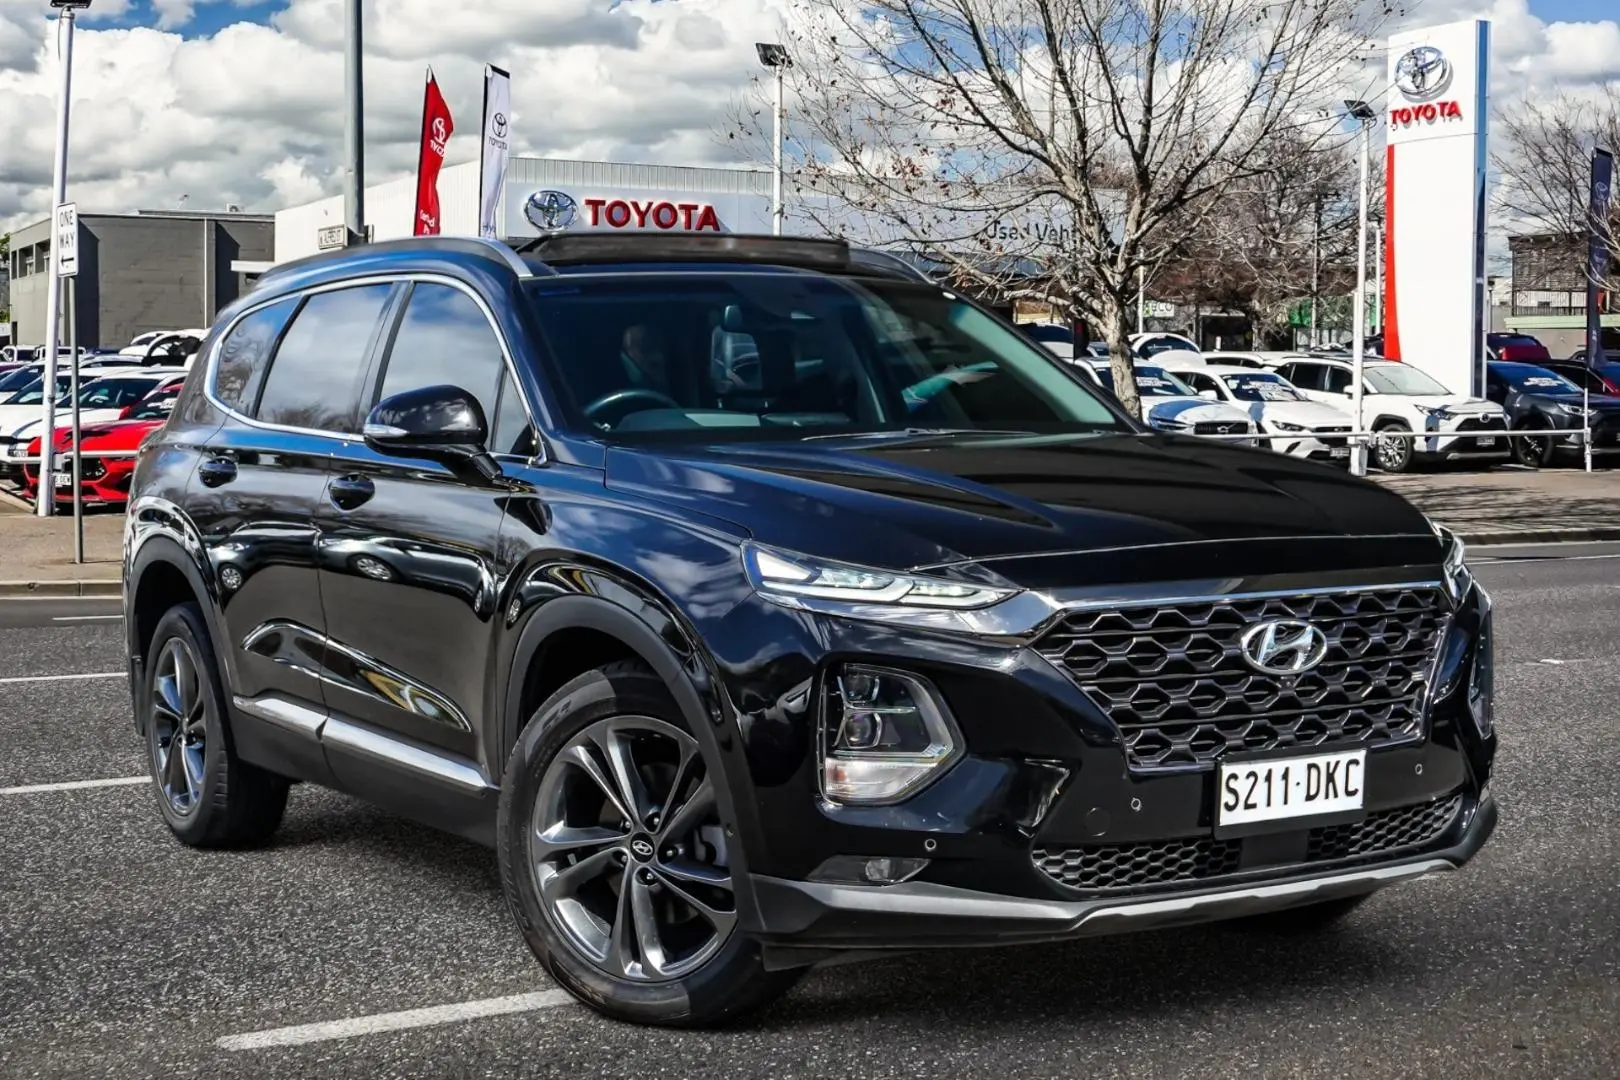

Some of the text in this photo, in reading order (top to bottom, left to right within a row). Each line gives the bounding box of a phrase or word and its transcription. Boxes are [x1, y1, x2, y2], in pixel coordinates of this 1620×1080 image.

[1389, 101, 1463, 125] TOYOTA
[488, 137, 508, 150] TOYOTA
[60, 210, 74, 228] ONE
[584, 199, 721, 231] TOYOTA
[60, 231, 75, 249] WAY
